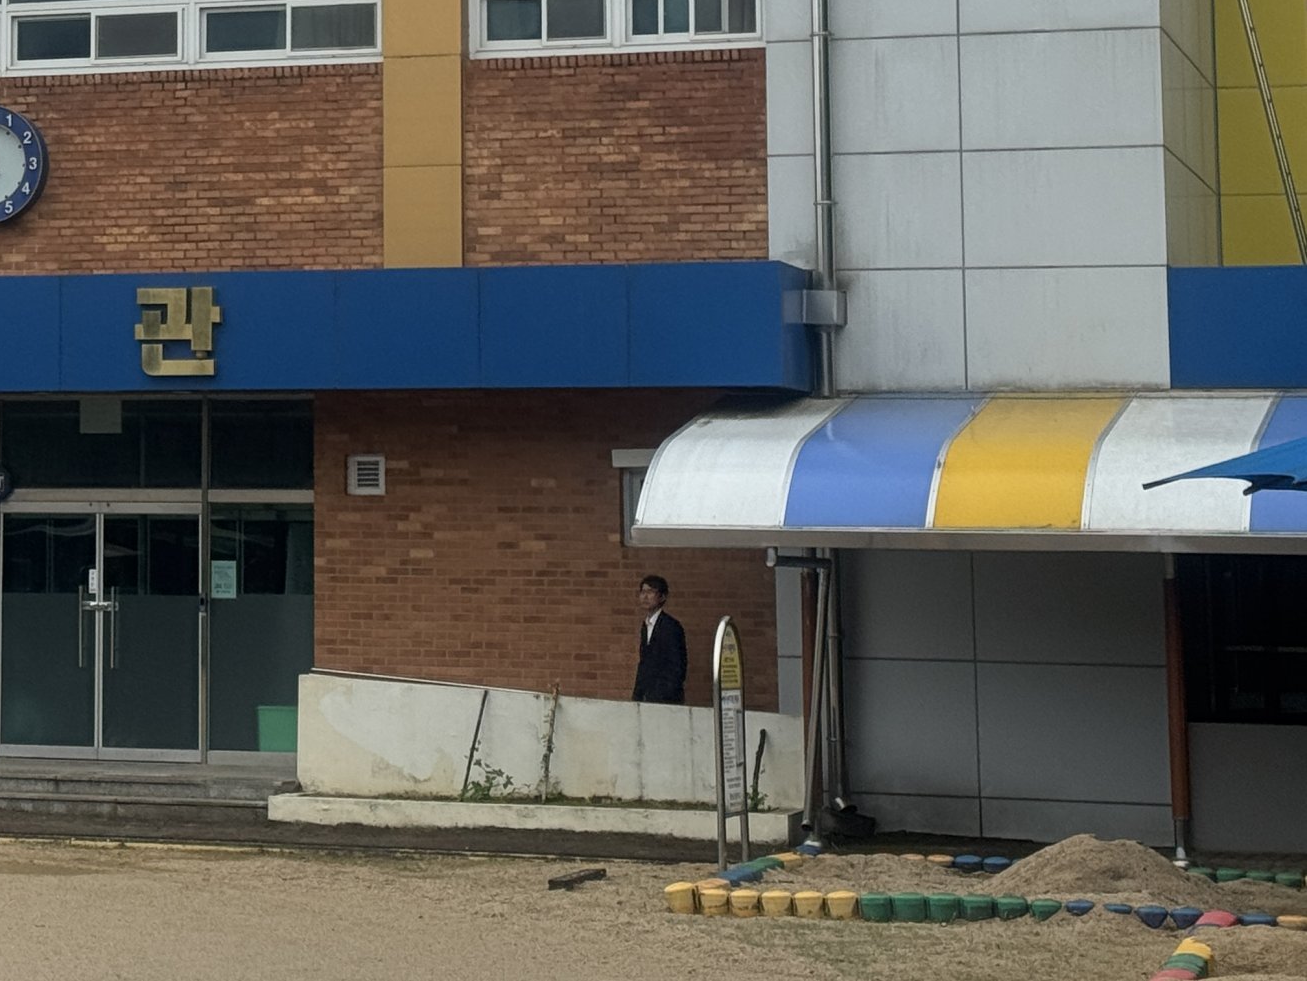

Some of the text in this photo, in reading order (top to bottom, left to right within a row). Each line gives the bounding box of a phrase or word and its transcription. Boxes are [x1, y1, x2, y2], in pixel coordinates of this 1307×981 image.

[6, 114, 12, 127] 1
[23, 131, 32, 144] 2
[29, 157, 37, 170] 3
[21, 182, 30, 195] 4
[4, 201, 13, 213] 5
